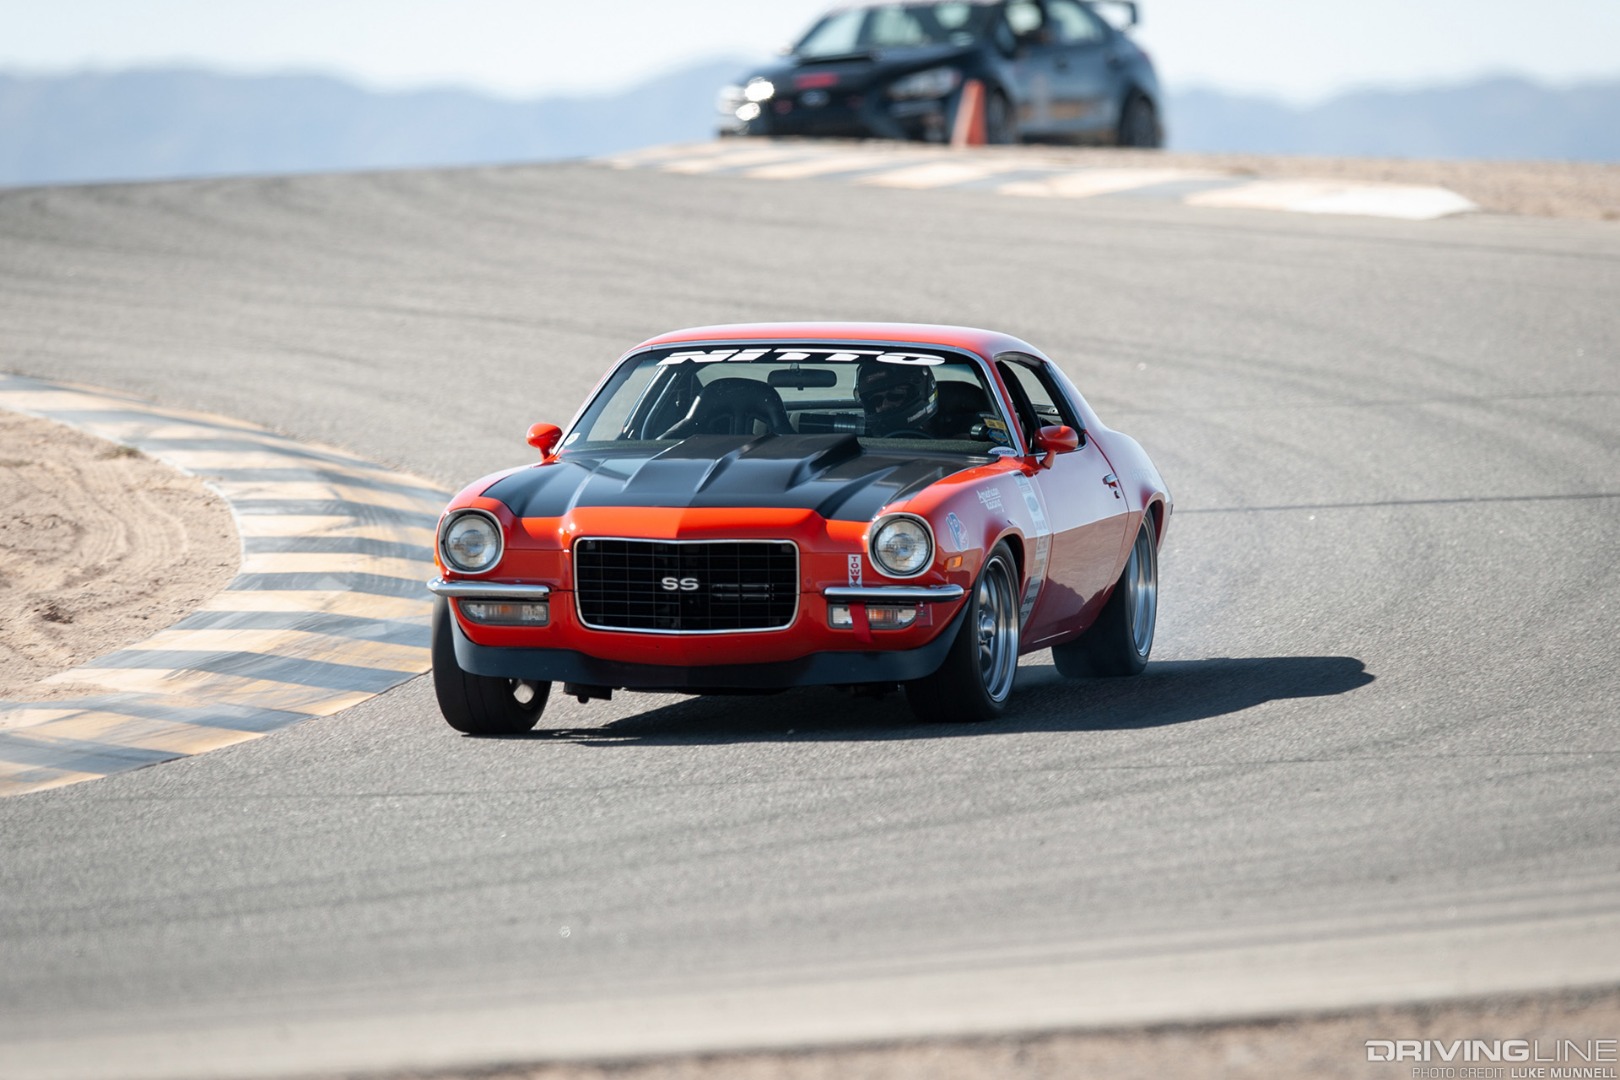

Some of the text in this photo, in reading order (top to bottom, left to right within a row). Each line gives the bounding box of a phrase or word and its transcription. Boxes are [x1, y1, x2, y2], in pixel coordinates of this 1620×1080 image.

[656, 348, 945, 366] NITTO
[850, 556, 860, 575] TOW
[661, 577, 699, 591] SS
